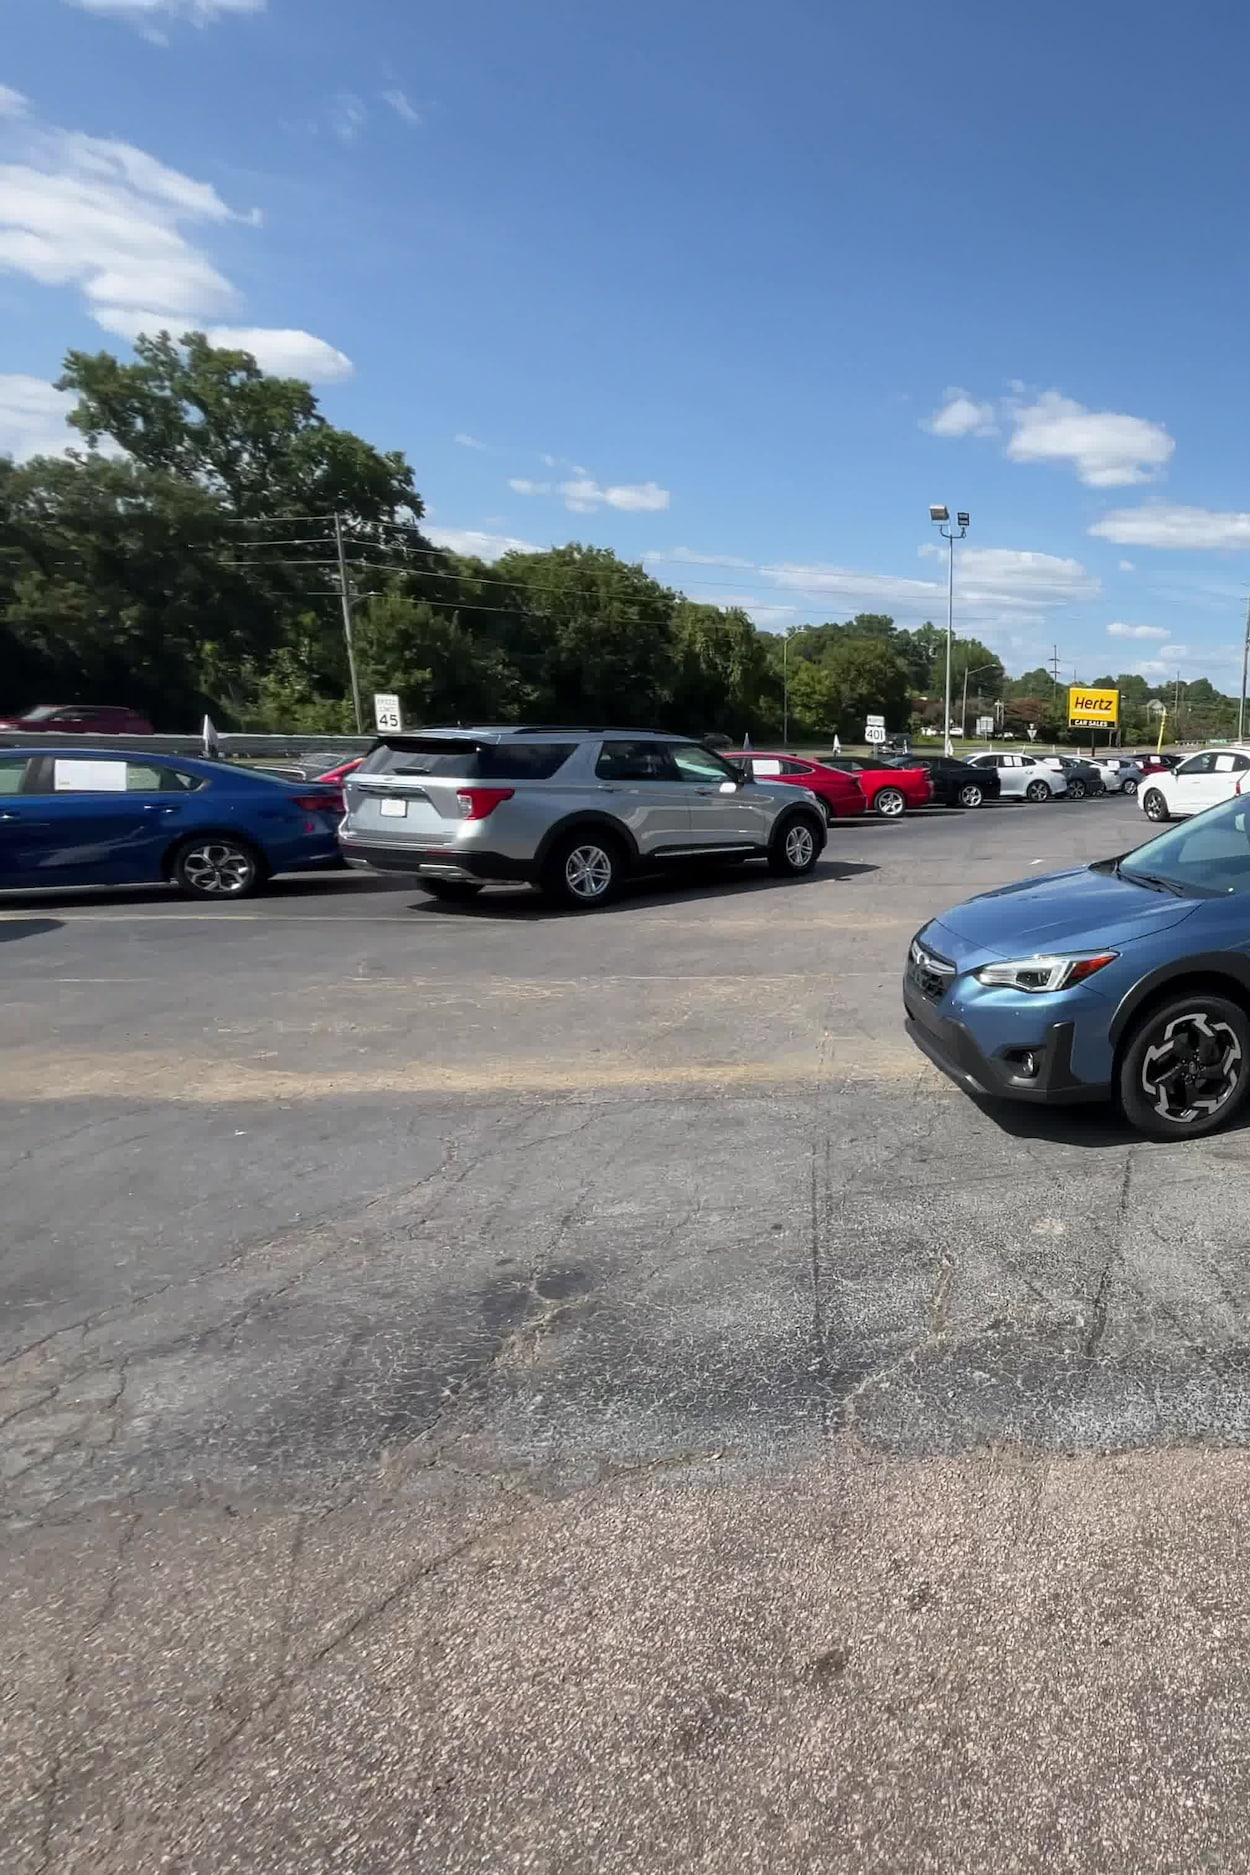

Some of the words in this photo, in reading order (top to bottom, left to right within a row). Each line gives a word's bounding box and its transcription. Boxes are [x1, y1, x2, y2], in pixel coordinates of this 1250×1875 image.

[1075, 697, 1113, 711] Hertz
[379, 714, 398, 727] 45
[867, 729, 883, 741] 401
